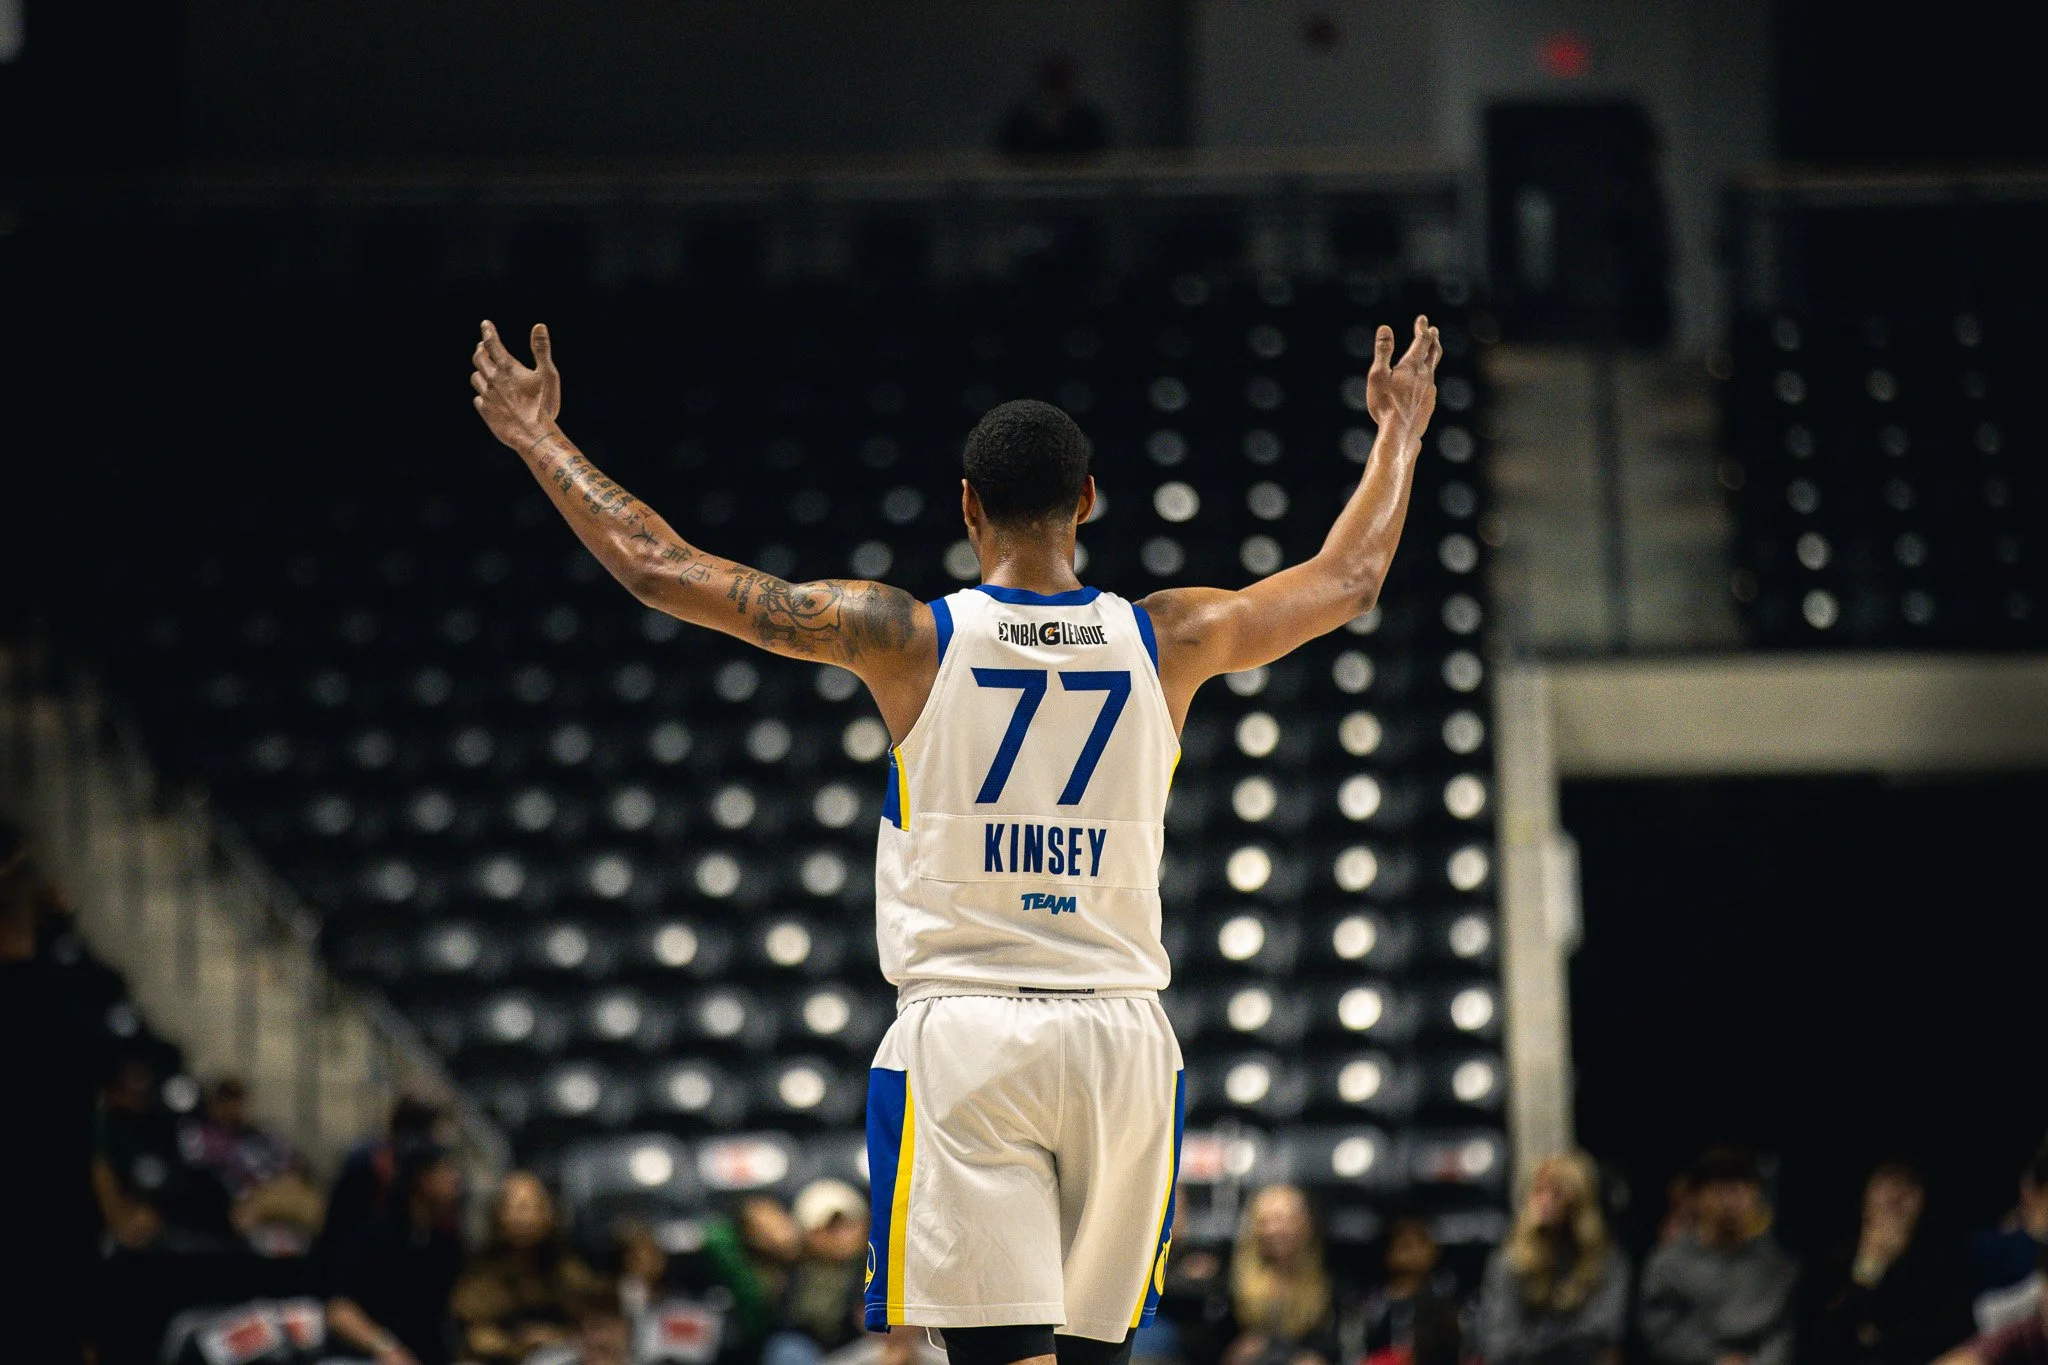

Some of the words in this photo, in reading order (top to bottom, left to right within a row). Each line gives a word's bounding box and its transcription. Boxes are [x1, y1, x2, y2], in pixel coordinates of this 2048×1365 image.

[1010, 622, 1038, 646] NBA
[1061, 621, 1108, 646] LEAGUE
[971, 667, 1132, 806] 77
[984, 823, 1107, 877] KINSEY
[1021, 892, 1077, 915] TEAM
